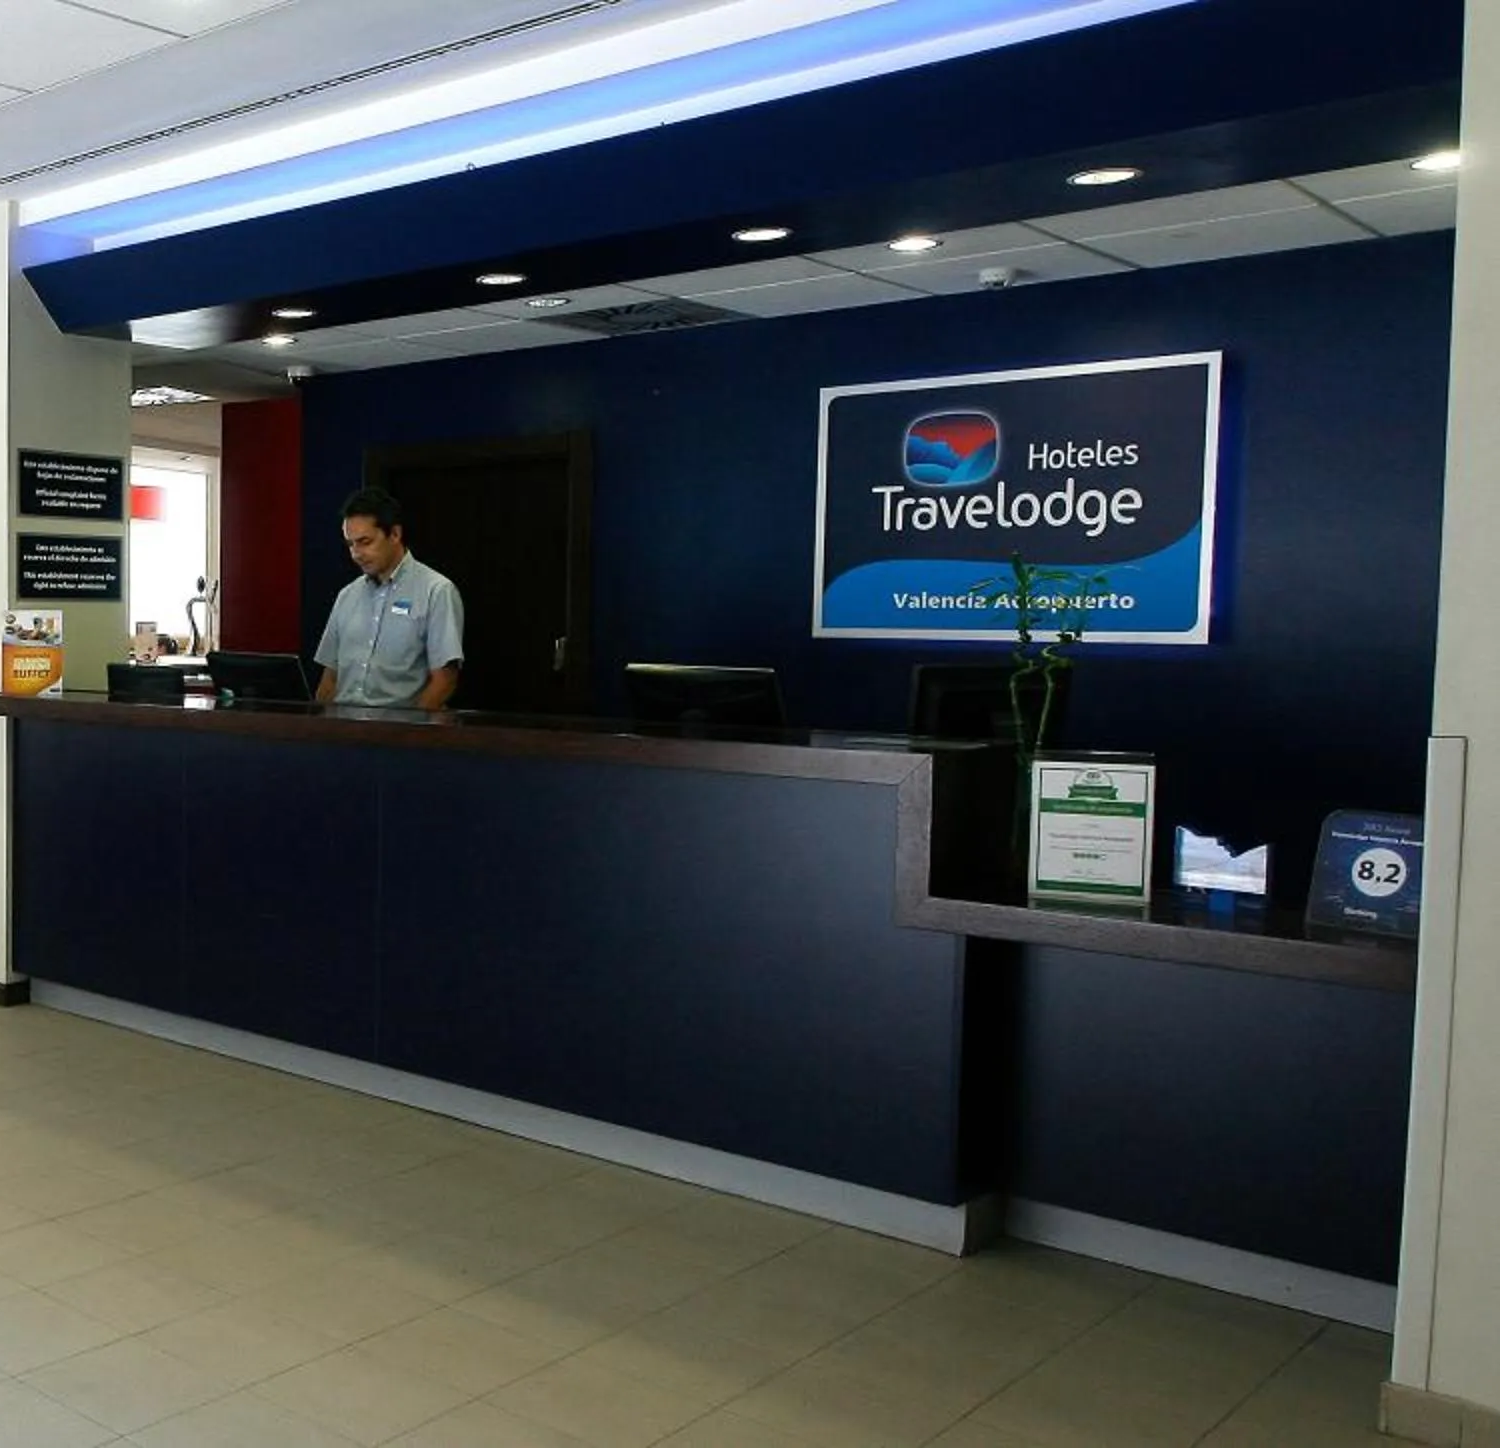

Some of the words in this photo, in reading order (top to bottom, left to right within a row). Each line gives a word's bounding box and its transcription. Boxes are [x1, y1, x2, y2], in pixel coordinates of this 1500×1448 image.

[1028, 440, 1139, 471] Hoteles
[872, 477, 1143, 537] Travelodge
[893, 591, 987, 609] Valencia
